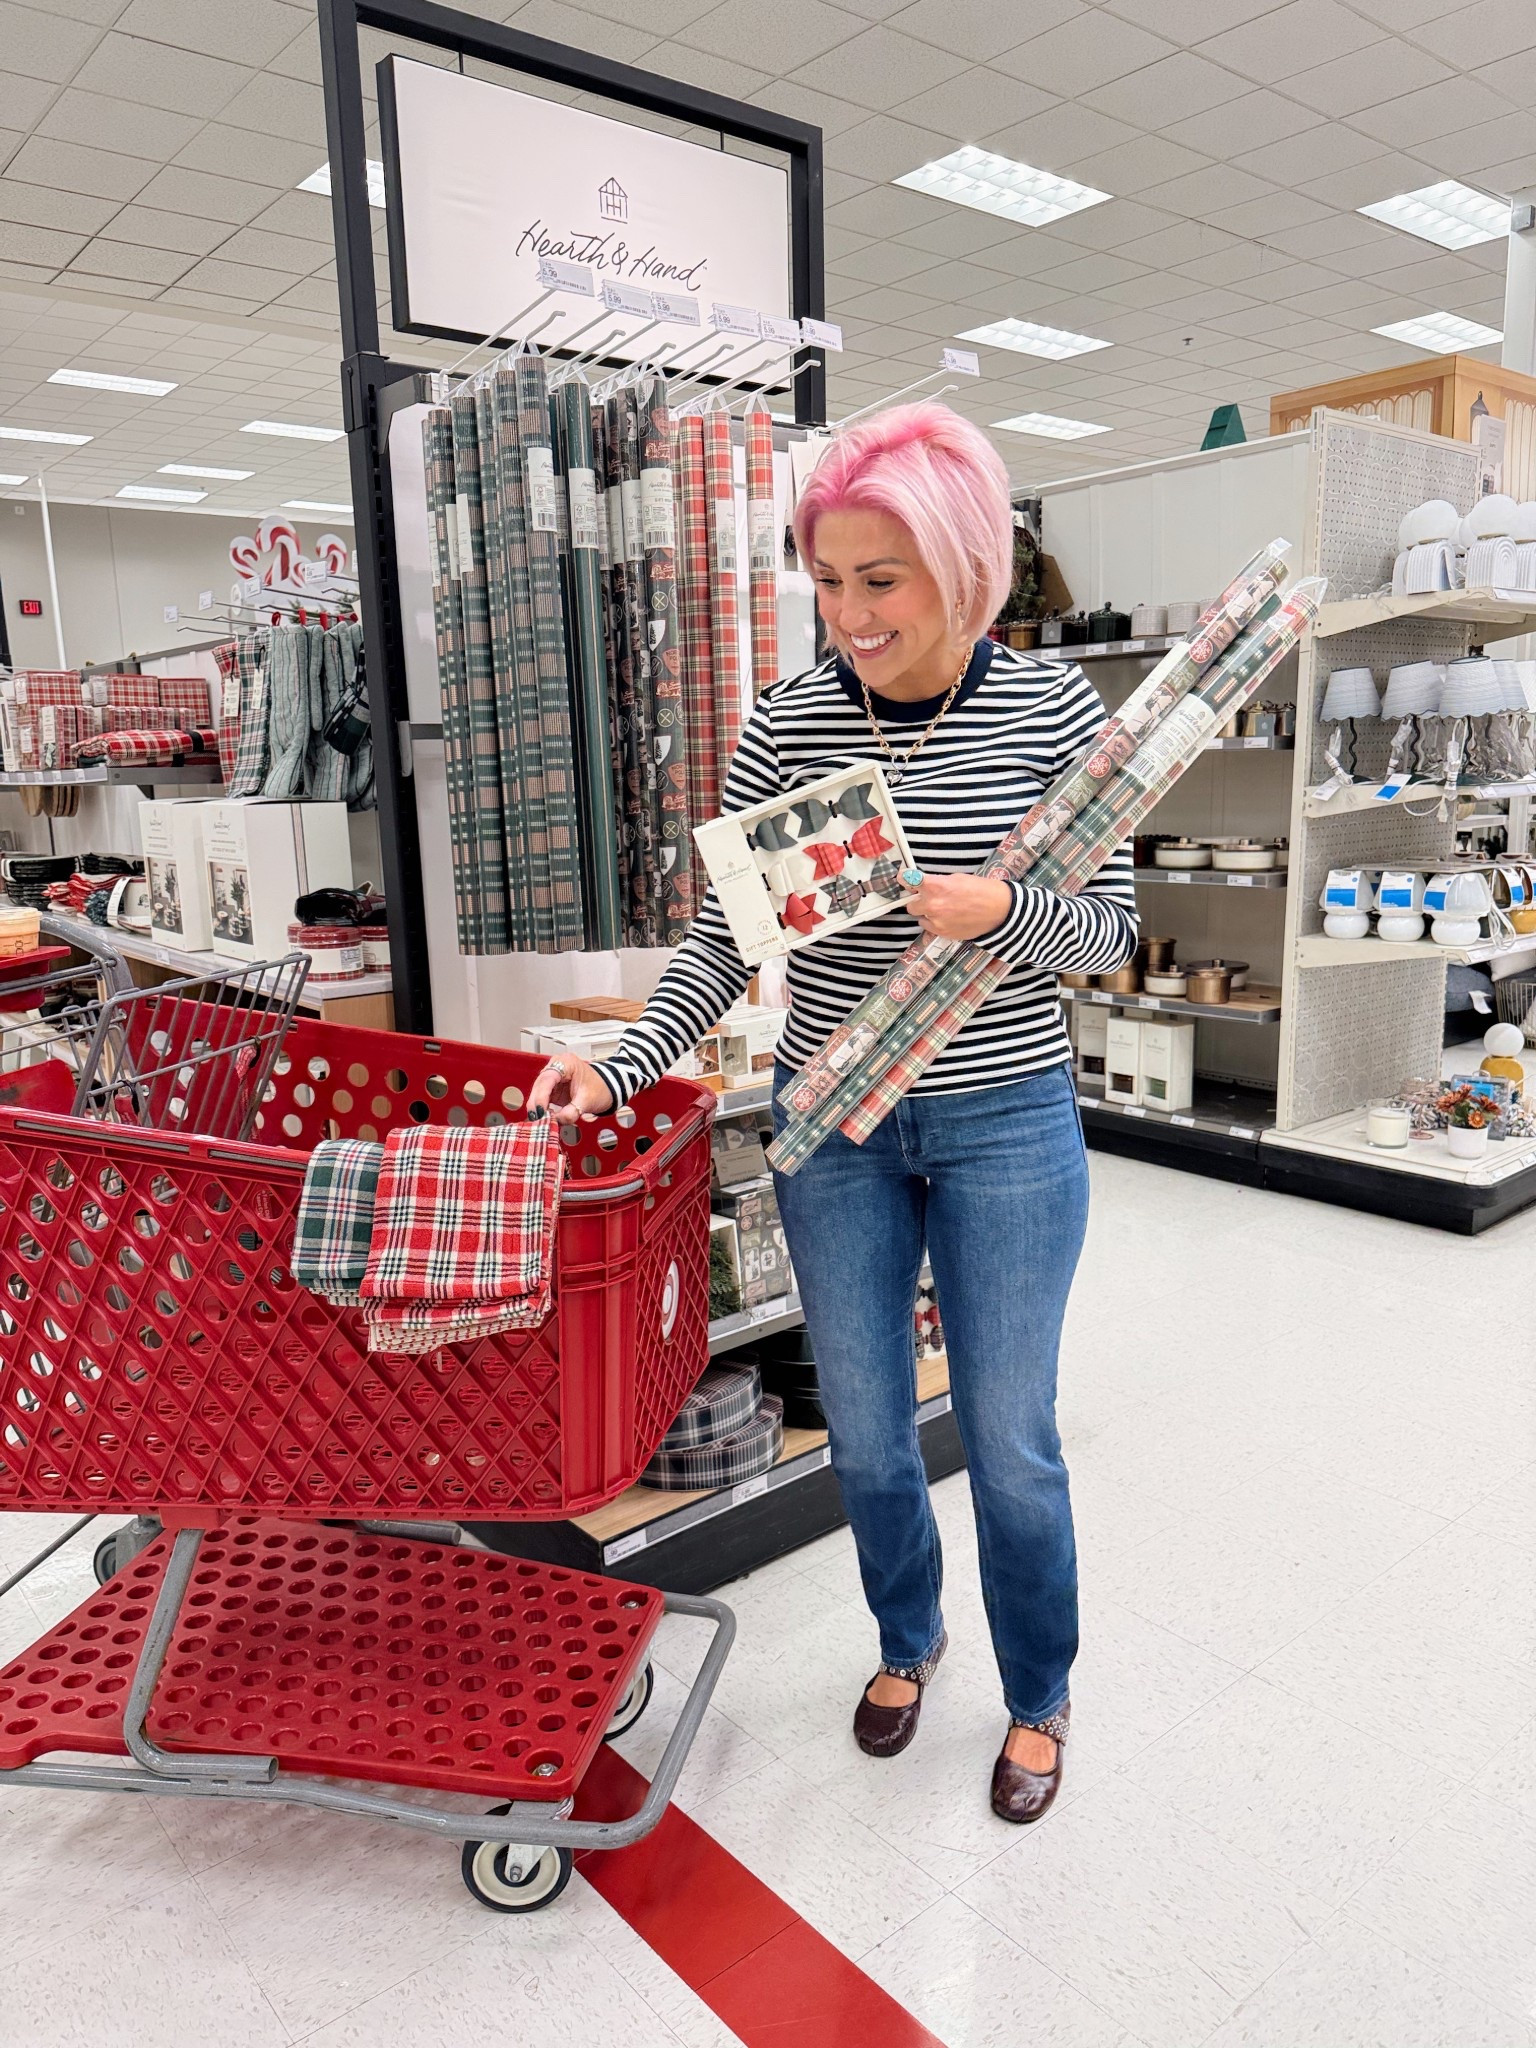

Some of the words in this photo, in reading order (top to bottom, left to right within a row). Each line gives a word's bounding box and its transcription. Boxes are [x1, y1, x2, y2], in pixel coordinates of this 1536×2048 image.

[515, 219, 615, 270] Hearth
[611, 241, 629, 275] &
[629, 246, 708, 292] Hand
[542, 267, 558, 278] 5.99
[608, 294, 622, 304] 5.99
[657, 302, 671, 312] 5.99
[718, 314, 731, 324] 5.99
[763, 326, 775, 335] 5.99
[23, 601, 40, 614] EXIT
[745, 944, 757, 953] GIFT
[757, 935, 779, 948] TOPPERS
